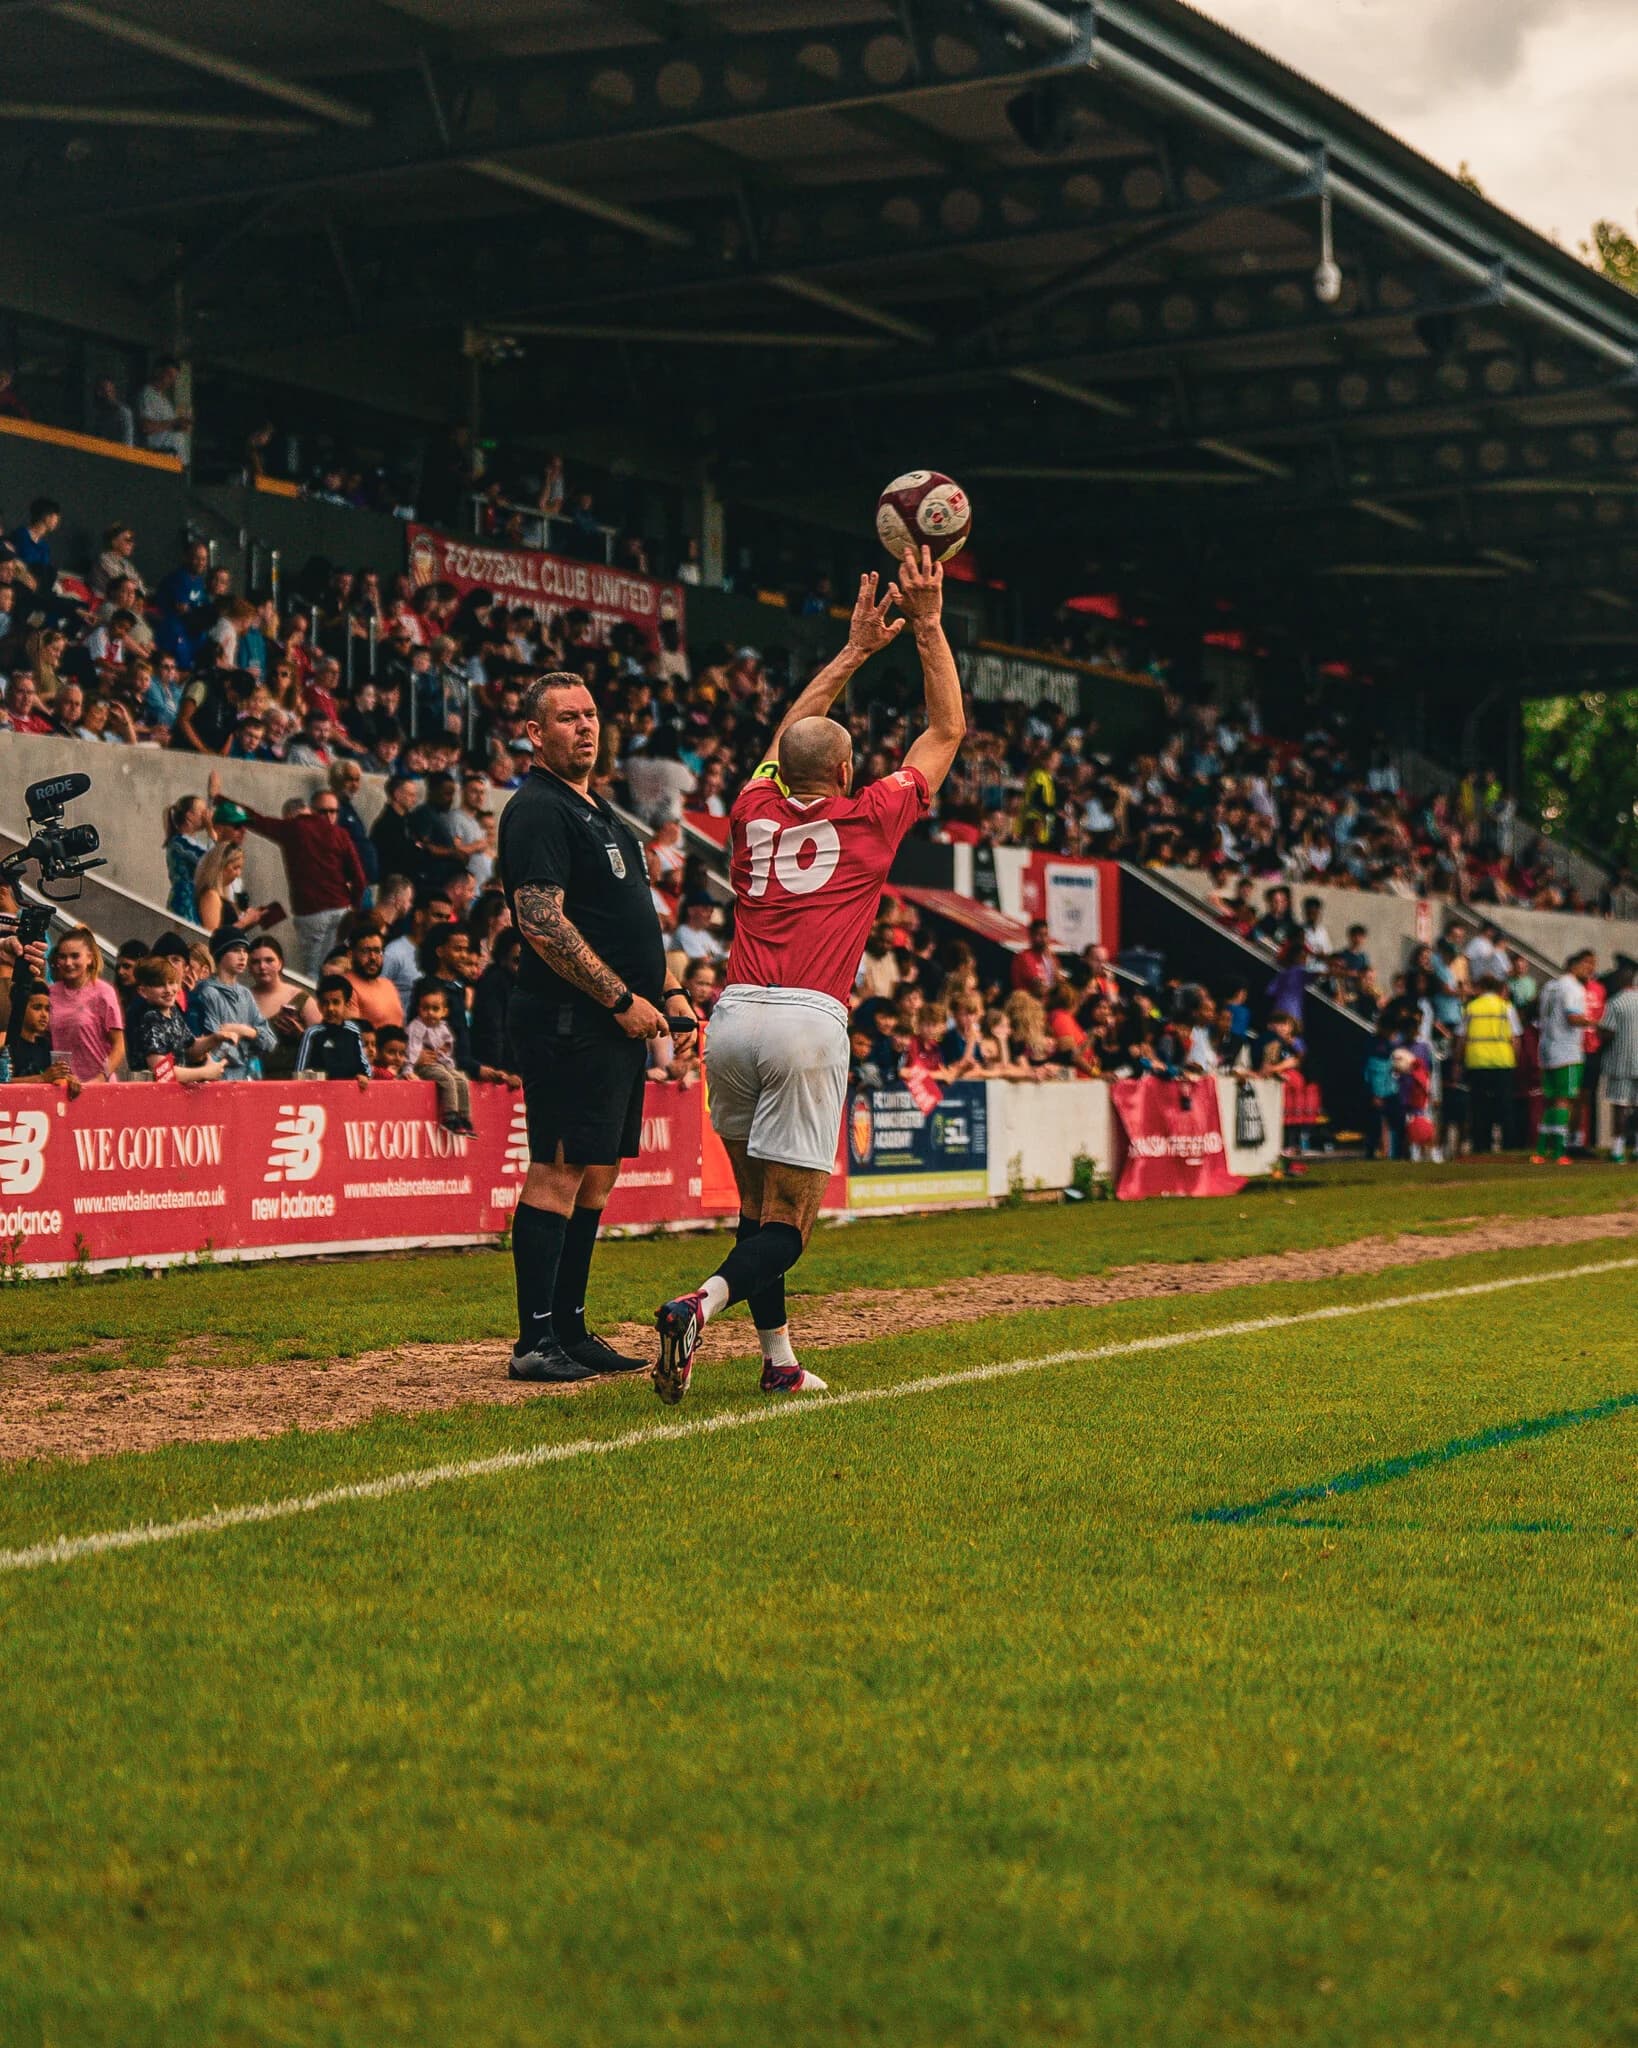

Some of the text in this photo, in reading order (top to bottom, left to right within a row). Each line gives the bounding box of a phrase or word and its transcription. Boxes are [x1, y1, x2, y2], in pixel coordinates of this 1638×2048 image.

[445, 542, 652, 615] FOOTBALL CLUB UNITED
[36, 778, 73, 800] RØDE
[746, 818, 841, 897] 10
[73, 1124, 225, 1171] WE GOT NOW
[344, 1121, 378, 1160] WE
[379, 1120, 421, 1159] GOT
[423, 1120, 469, 1158] NOW
[74, 1184, 226, 1214] www.newbalanceteam.co.uk
[344, 1175, 473, 1199] www.newbalanceteam.co.uk
[491, 1187, 515, 1208] new
[252, 1190, 335, 1221] new balance
